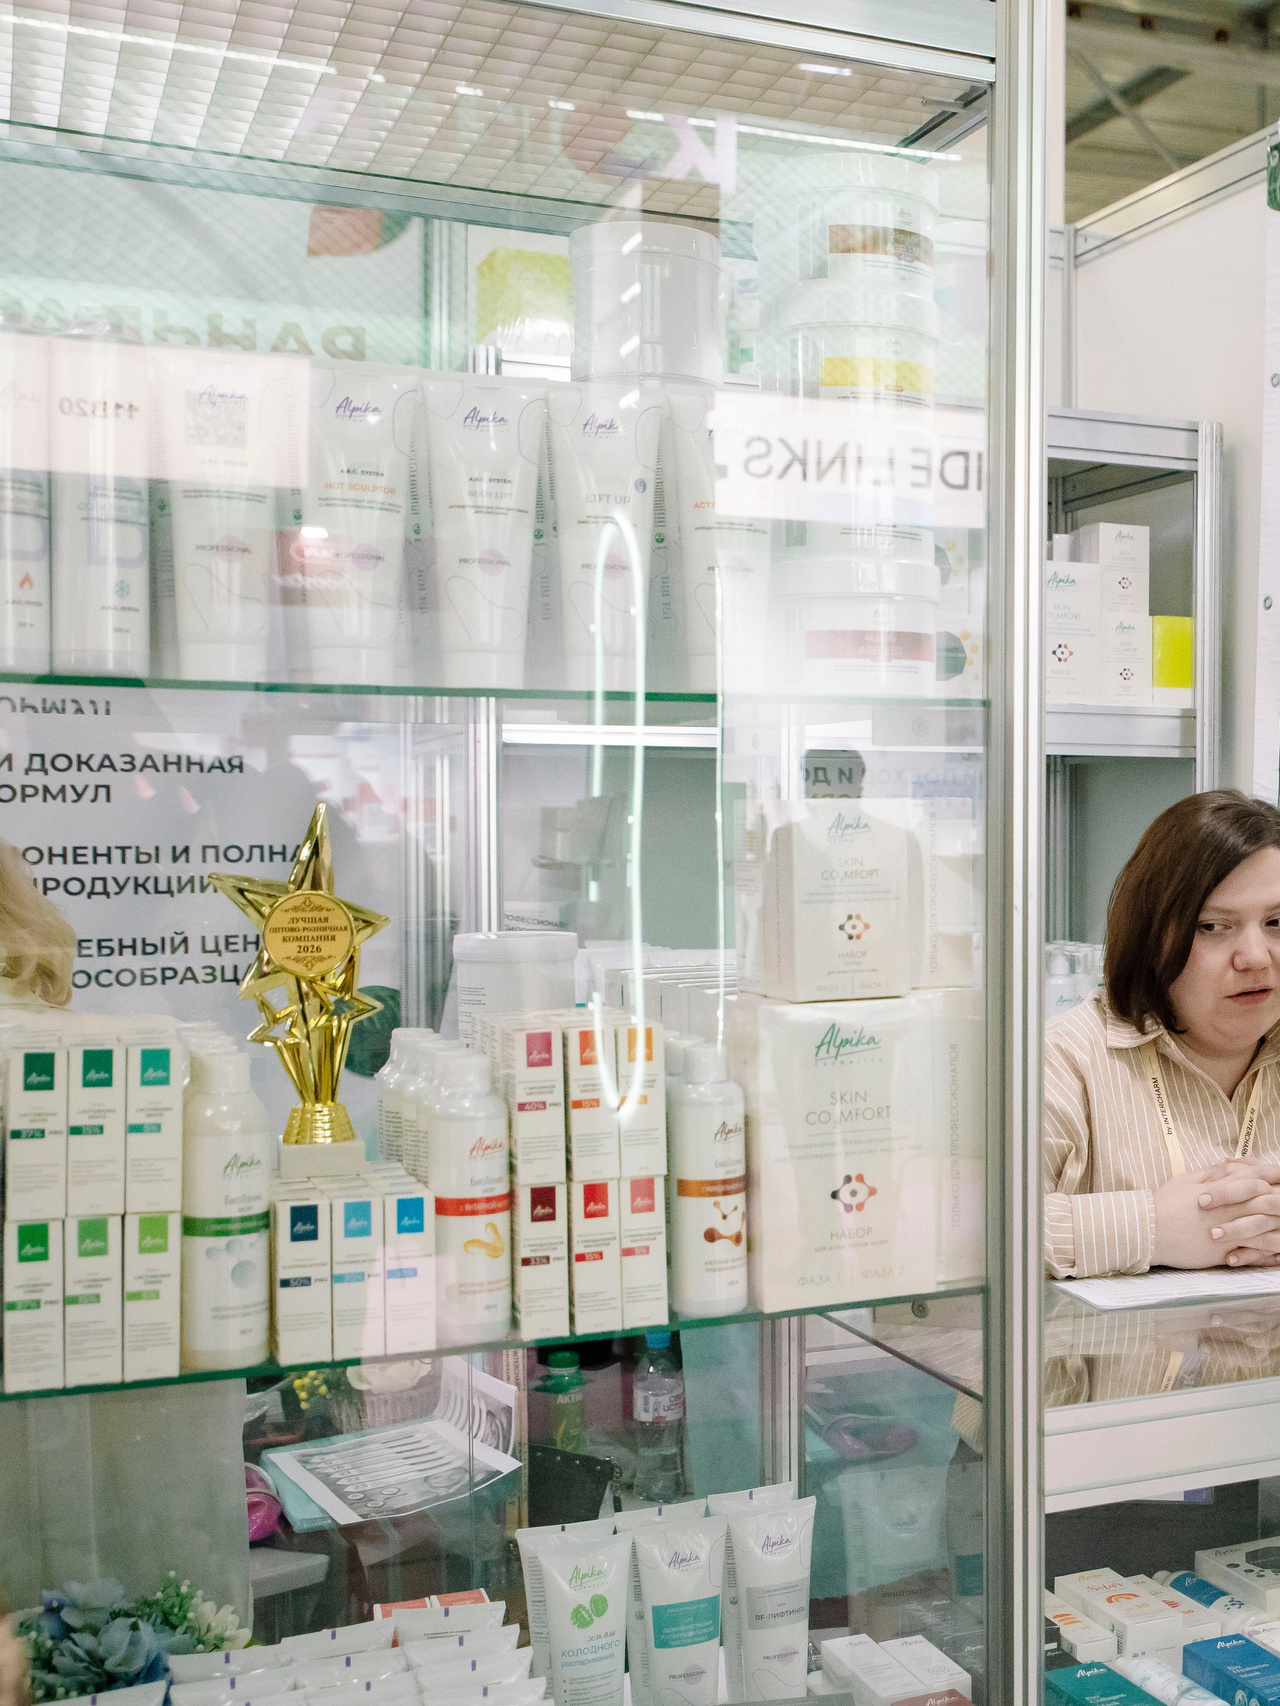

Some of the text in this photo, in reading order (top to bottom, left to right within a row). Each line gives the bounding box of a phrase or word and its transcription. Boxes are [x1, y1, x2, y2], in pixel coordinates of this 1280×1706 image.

[336, 396, 382, 418] Alpika
[463, 406, 509, 429] Alpika
[583, 413, 625, 436] Alpik
[325, 482, 397, 496] HOT SCULPTOR
[614, 494, 631, 505] UP
[196, 545, 252, 554] PROFESSIONAL
[459, 557, 511, 567] PROFESSIONAL
[1047, 571, 1077, 588] Alpika
[24, 753, 244, 776] ДОКАЗАННАЯ
[828, 812, 871, 837] Alpika
[22, 845, 160, 866] ОНЕНТЫ
[172, 845, 190, 864] И
[838, 858, 864, 868] SKIN
[33, 875, 217, 899] РОДУКЦИИ
[288, 917, 329, 925] ЛУЧШАЯ
[269, 926, 349, 934] ОПТОВО-РОЗНИЧНАЯ
[77, 931, 260, 958] ЕБНЫЙ ЦЕН
[282, 935, 336, 943] КОМПАНИЯ
[296, 944, 322, 954] 2026
[838, 951, 867, 960] НАБОР
[72, 963, 248, 989] ОСОБРАЗЦ
[815, 1022, 882, 1060] Alpika
[830, 1089, 868, 1106] SKIN
[1152, 1077, 1170, 1125] INTERCHARM
[949, 1042, 960, 1229] ТОЛЬКО ДЛЯ ПРОФЕССИОНАЛОВ
[1241, 1115, 1255, 1157] INTERCHARM
[830, 1227, 872, 1241] НАБОР
[798, 1273, 831, 1286] ФАЗА
[862, 1268, 897, 1279] ФАЗА
[761, 1534, 792, 1552] Alpika
[668, 1551, 701, 1569] Alpika
[569, 1565, 605, 1586] Alpika
[755, 1607, 805, 1621] RF-ЛИФТИНГА
[561, 1639, 620, 1658] ХОЛОДНОГО
[1217, 1637, 1247, 1649] Alpika
[763, 1650, 799, 1661] PROFESSIONAL
[669, 1669, 707, 1680] PROFESSIONAL
[1076, 1666, 1107, 1679] Alpika
